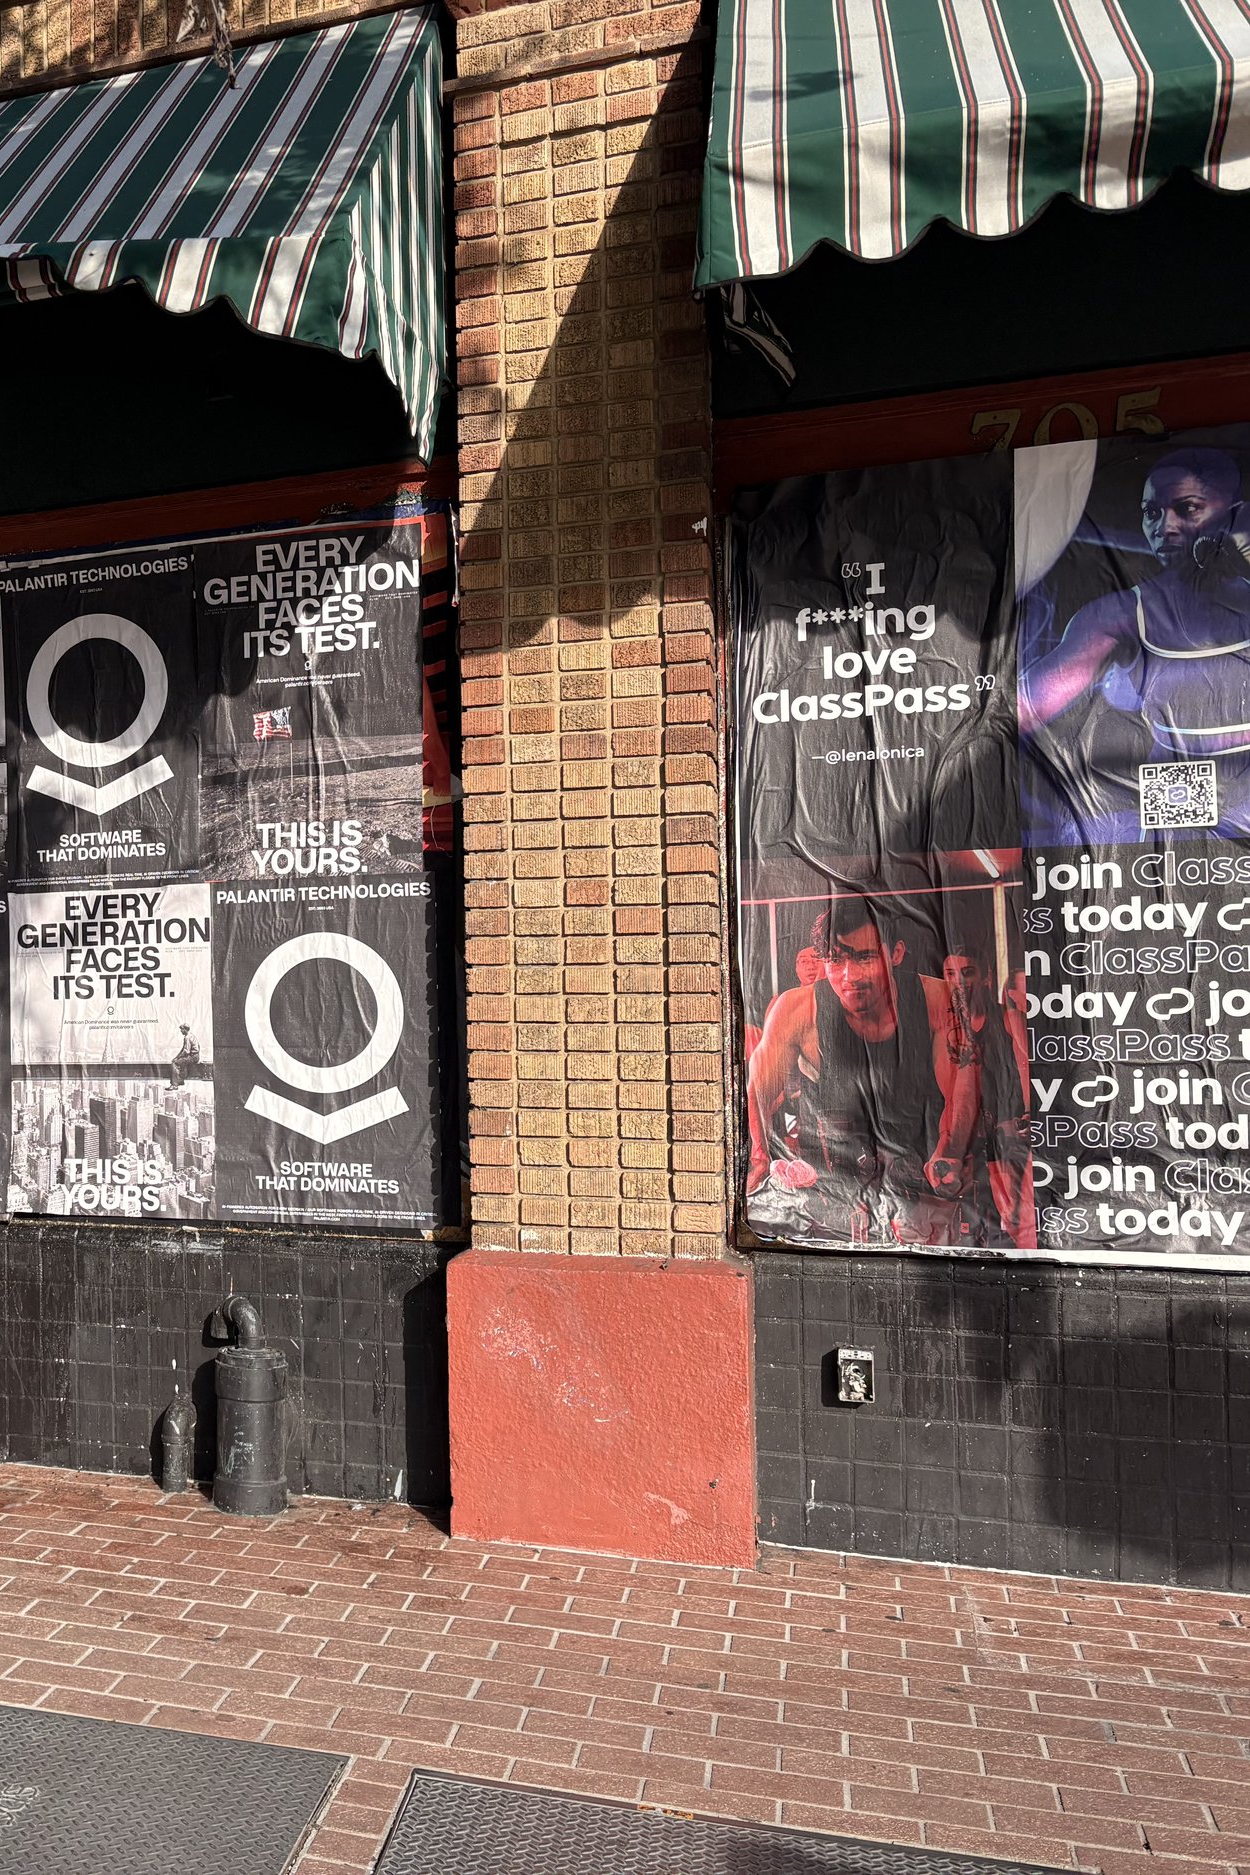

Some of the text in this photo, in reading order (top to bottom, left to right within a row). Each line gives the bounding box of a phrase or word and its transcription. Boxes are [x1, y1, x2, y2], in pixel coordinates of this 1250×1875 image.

[70, 556, 188, 584] TECHNOLOGIES
[255, 535, 365, 573] EVERY
[203, 559, 420, 606] GENERATION
[258, 593, 364, 629] FACES
[243, 621, 380, 659] ITS TEST.
[823, 646, 917, 680] love
[60, 829, 142, 847] SOFTWARE
[256, 820, 363, 848] THIS IS
[37, 842, 166, 862] THAT DOMINATES
[251, 847, 368, 875] YOURS.
[216, 882, 431, 904] PALANTIR TECHNOLOGIES
[1032, 854, 1123, 900] join
[65, 892, 161, 920] EVERY
[1023, 896, 1209, 937] s today
[17, 917, 210, 949] GENERATION
[66, 946, 161, 973] FACES
[1060, 939, 1250, 976] ClassPa
[53, 973, 175, 1000] ITS TEST.
[1205, 980, 1250, 1026] jo
[1030, 1078, 1063, 1112] y
[1129, 1069, 1223, 1114] join
[1166, 1114, 1249, 1149] tod
[64, 1158, 163, 1185] THIS IS
[255, 1176, 400, 1194] THAT DOMINATES
[280, 1161, 373, 1178] SOFTWARE
[1064, 1155, 1250, 1200] join Cla
[62, 1184, 167, 1212] YOURS.
[1035, 1201, 1245, 1246] ss today
